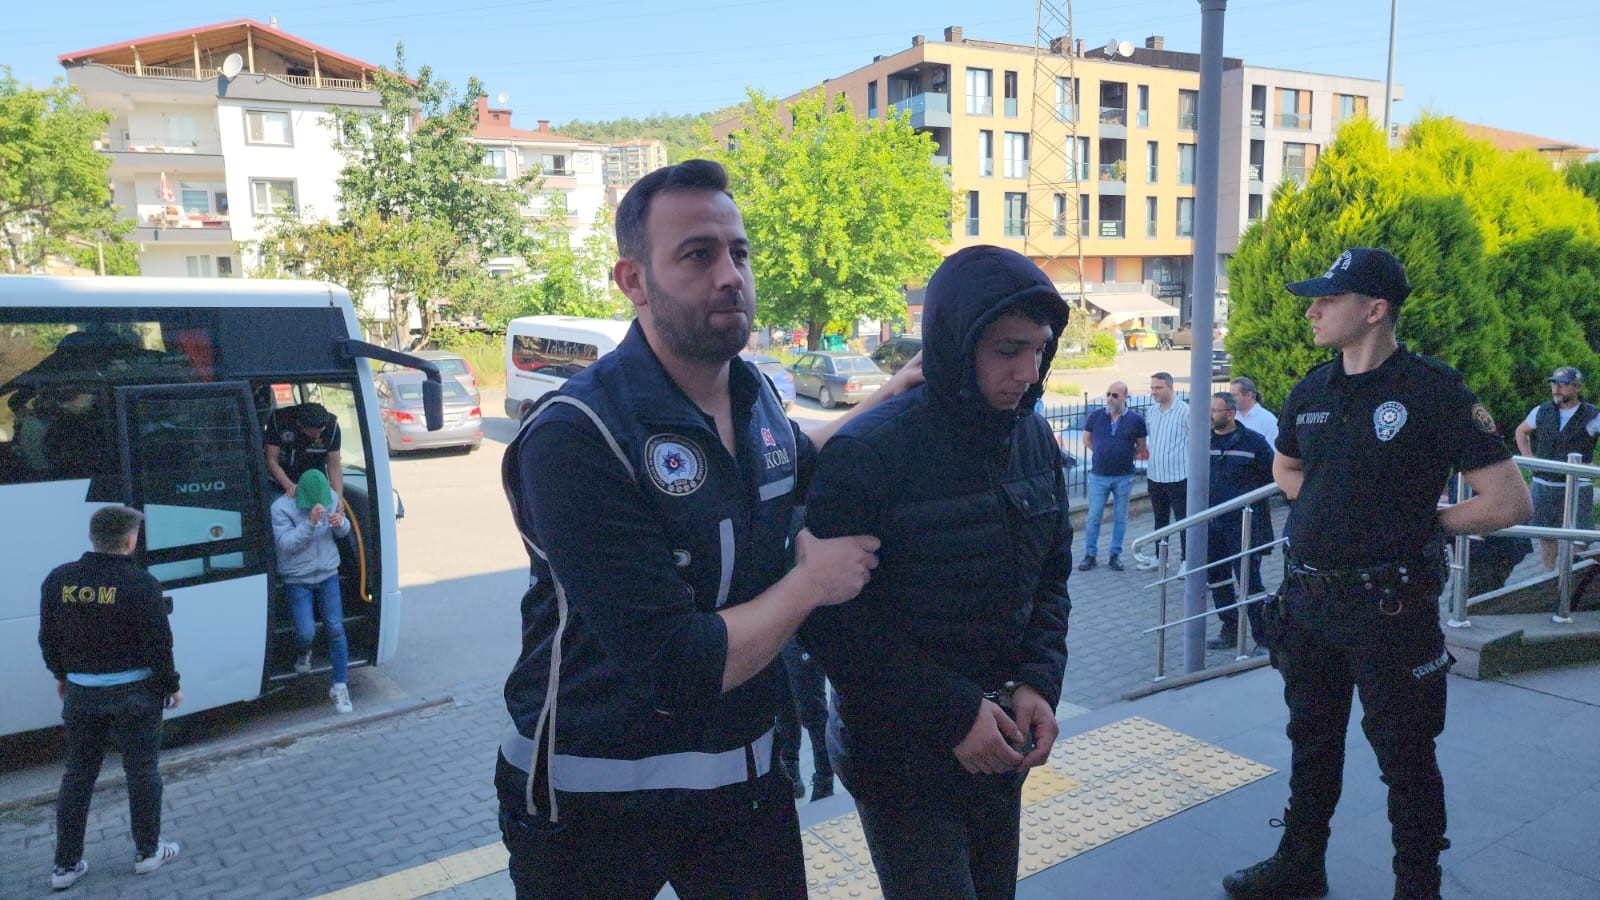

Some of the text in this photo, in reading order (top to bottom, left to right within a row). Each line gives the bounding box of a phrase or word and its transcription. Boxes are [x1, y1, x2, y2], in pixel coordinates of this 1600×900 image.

[763, 448, 790, 469] KOM
[176, 481, 225, 494] NOVO
[62, 585, 117, 604] KOM
